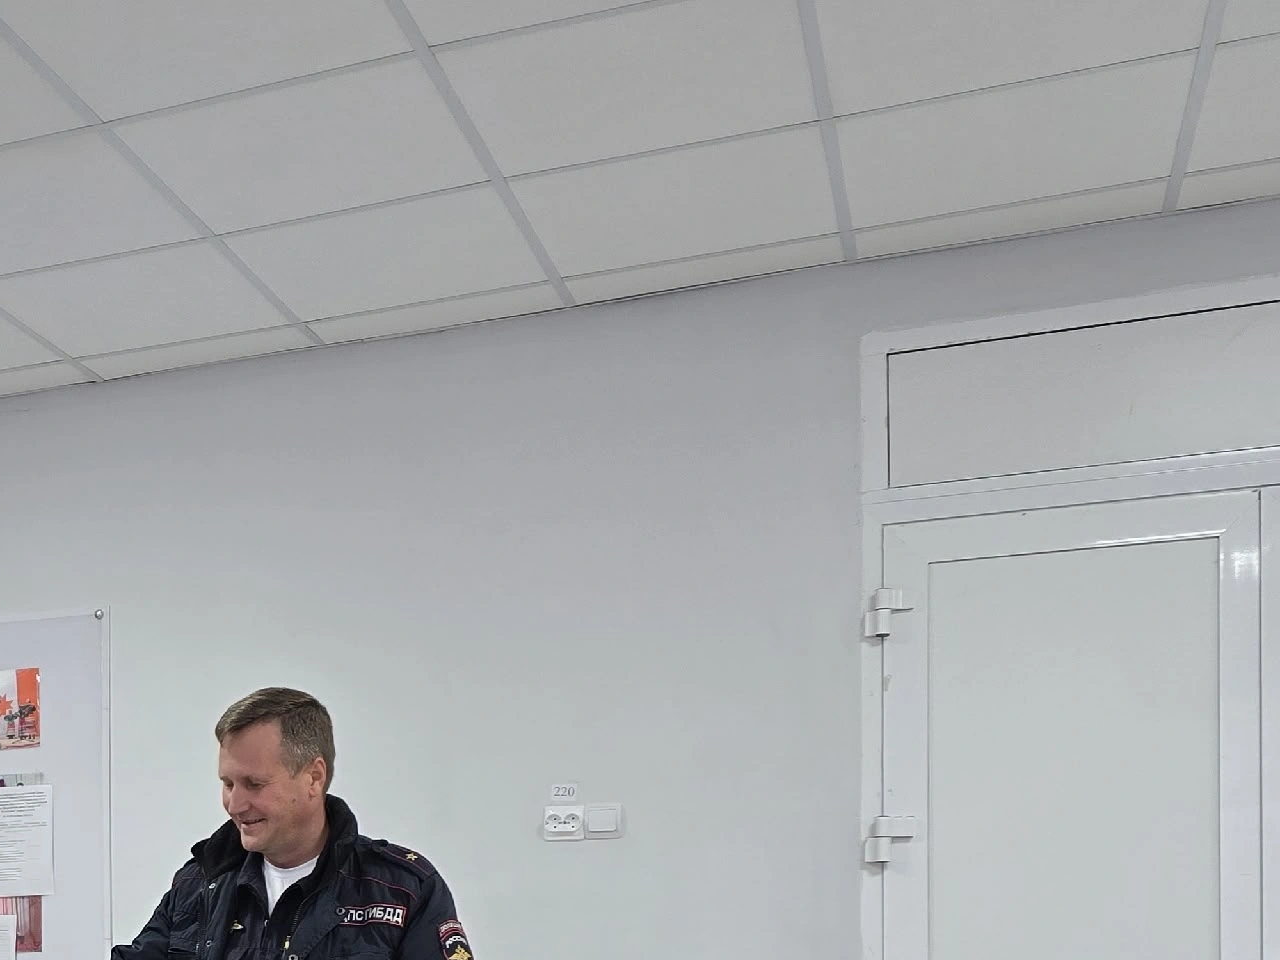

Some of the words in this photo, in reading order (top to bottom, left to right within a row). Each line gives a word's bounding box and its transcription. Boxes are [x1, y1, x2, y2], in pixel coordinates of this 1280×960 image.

[554, 786, 575, 797] 220
[344, 909, 364, 922] ПС
[364, 906, 403, 925] ГИБДД
